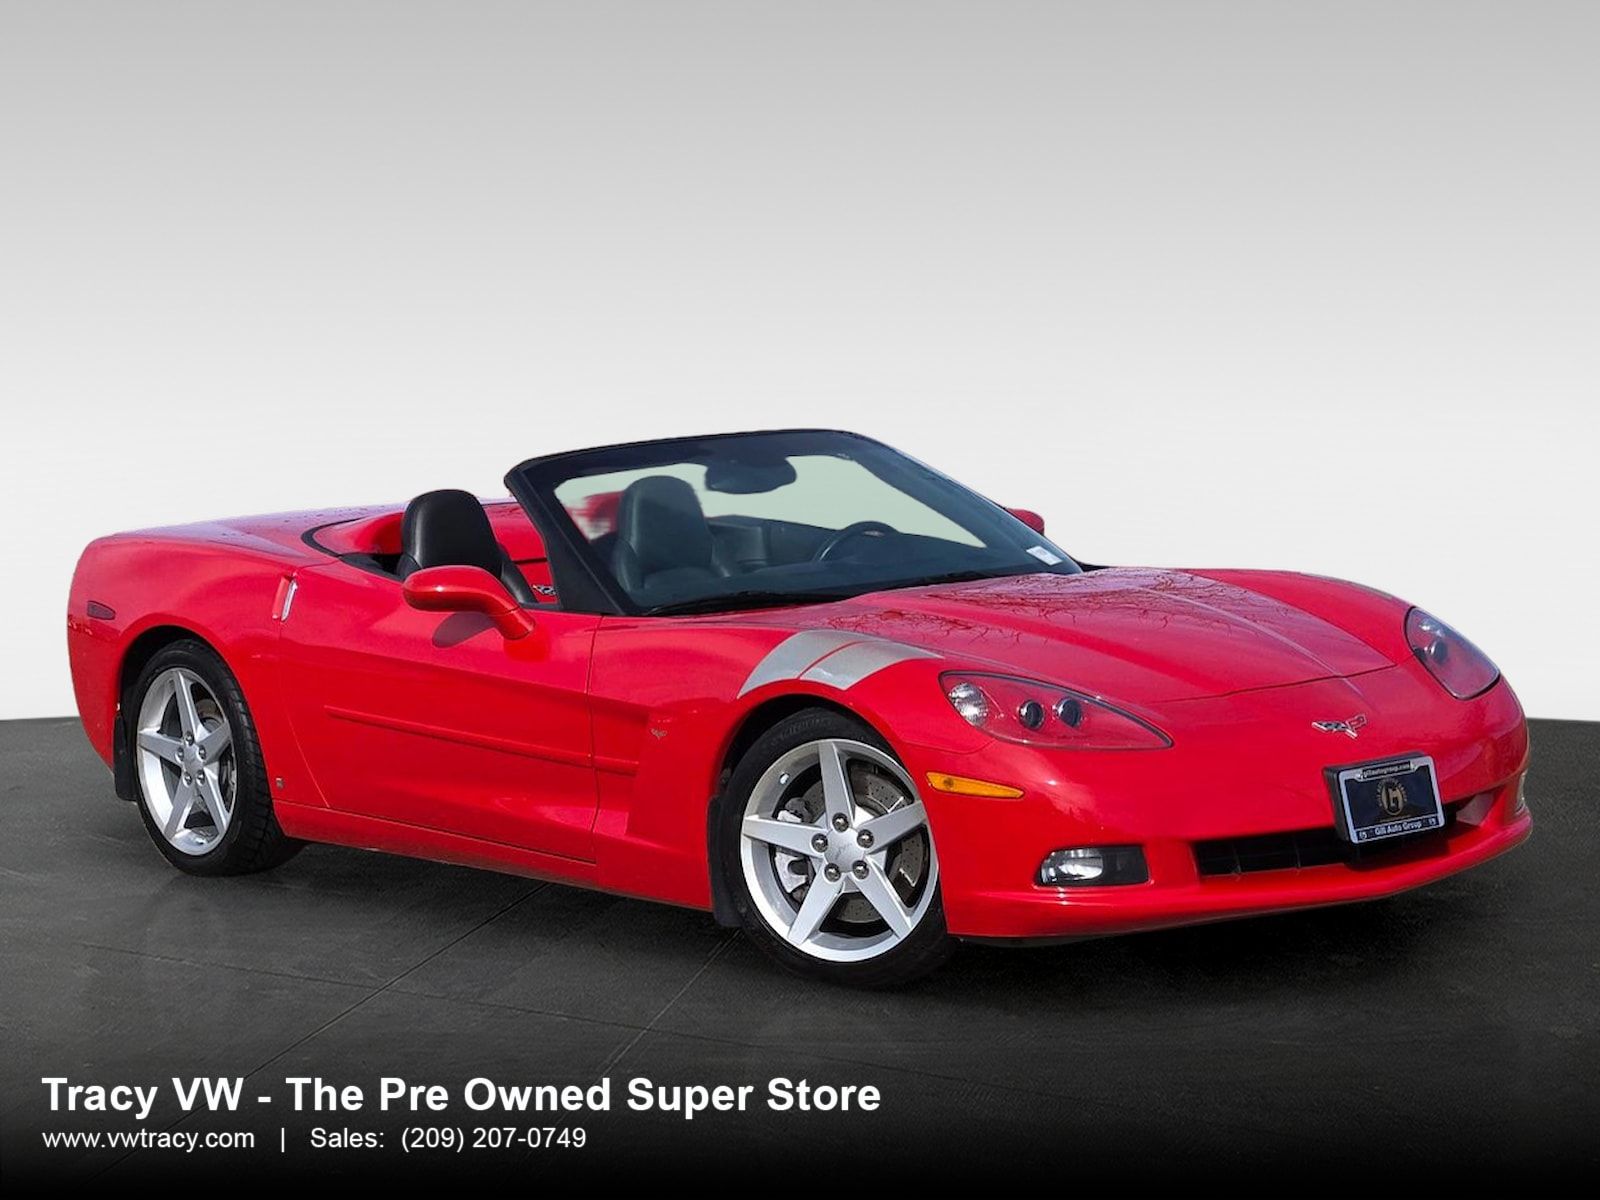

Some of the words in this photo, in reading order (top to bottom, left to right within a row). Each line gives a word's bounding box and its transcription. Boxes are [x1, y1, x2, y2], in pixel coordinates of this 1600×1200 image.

[1375, 827, 1387, 835] Gill
[1387, 824, 1402, 833] Auto
[1402, 821, 1422, 830] Group
